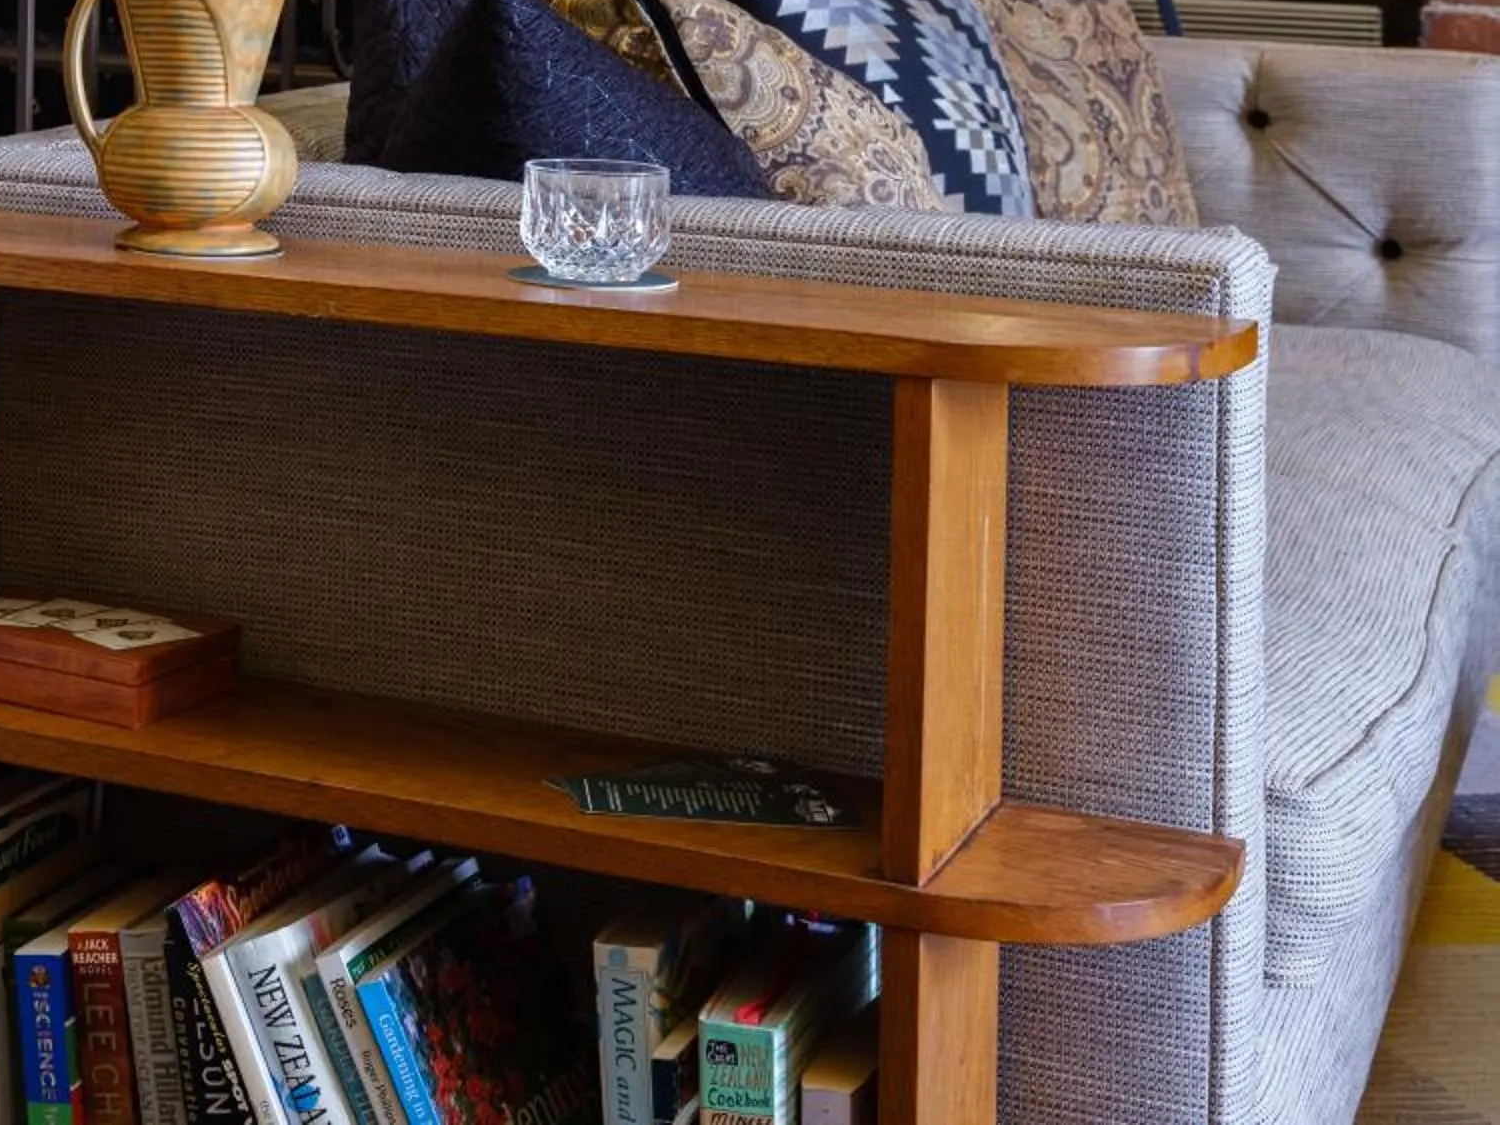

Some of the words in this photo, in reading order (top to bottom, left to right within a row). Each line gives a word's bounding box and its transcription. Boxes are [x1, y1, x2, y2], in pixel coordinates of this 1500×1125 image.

[72, 952, 119, 964] REACHER
[79, 964, 113, 975] NOVEL
[84, 938, 109, 950] JACK
[82, 982, 118, 1052] LEE
[142, 957, 175, 1056] Edmund
[330, 978, 358, 1029] Roses
[612, 977, 636, 1071] MAGIC
[34, 999, 58, 1101] SCIENCE
[248, 963, 297, 1028] NEW
[274, 1034, 332, 1125] ZEALA
[379, 1013, 420, 1102] Gardening
[614, 1077, 636, 1124] and
